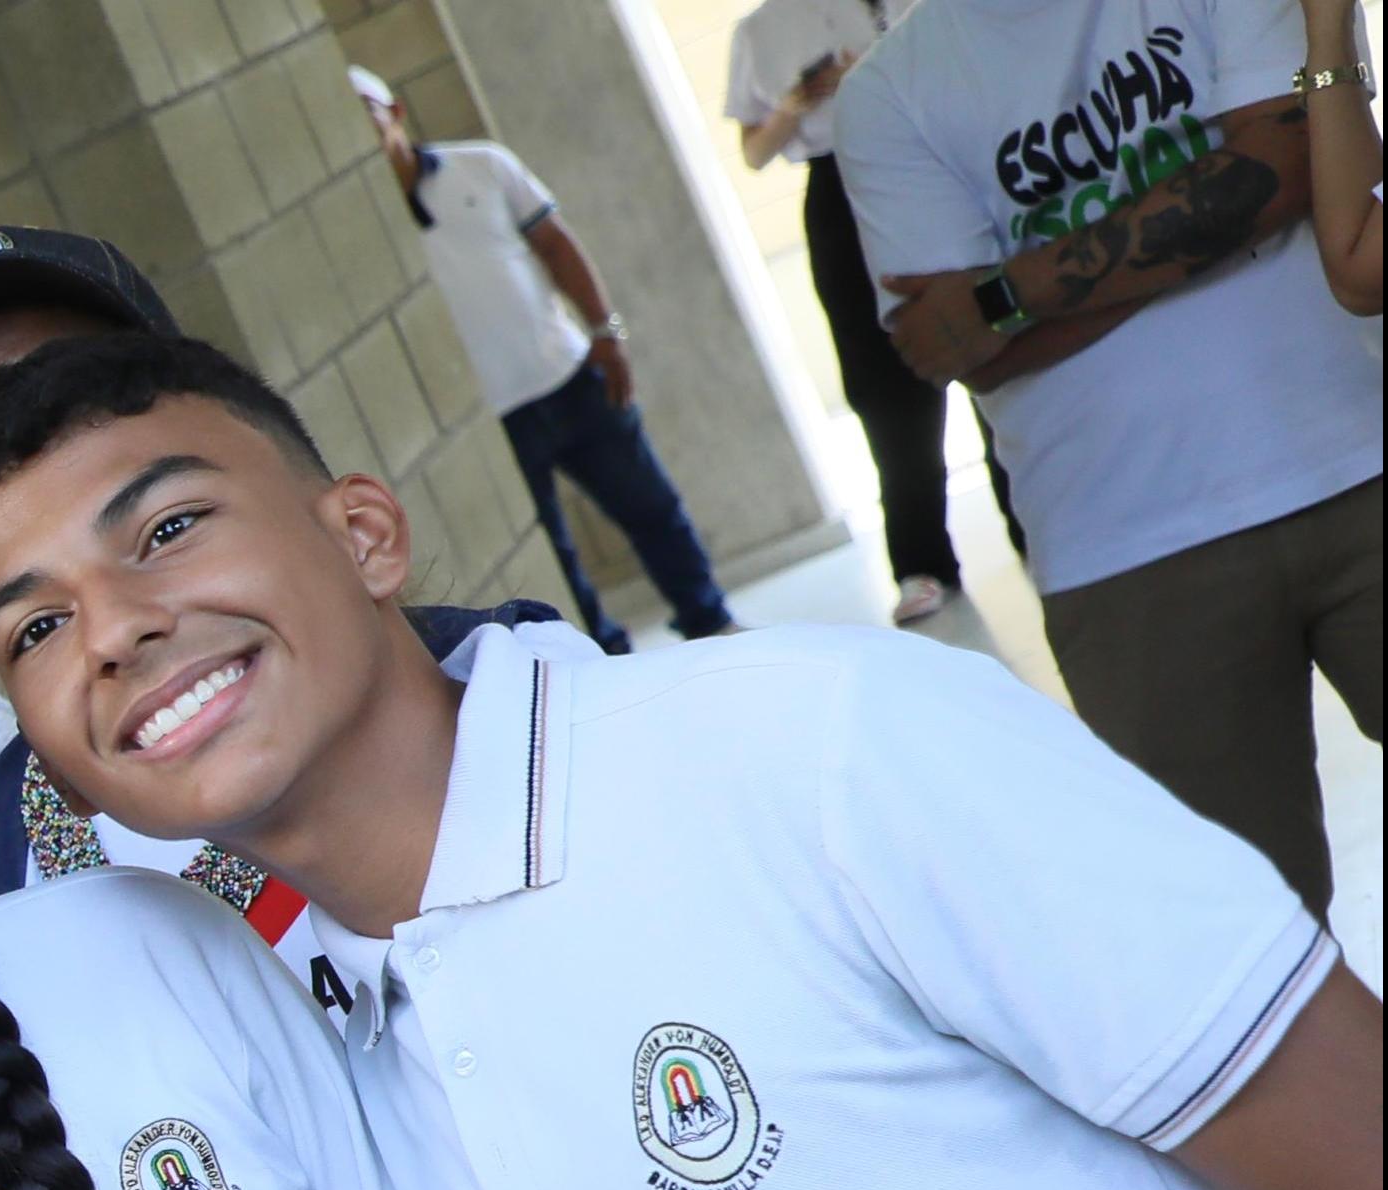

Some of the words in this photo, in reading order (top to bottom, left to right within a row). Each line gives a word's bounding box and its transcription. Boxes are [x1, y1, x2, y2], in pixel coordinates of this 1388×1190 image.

[665, 1029, 694, 1044] VON
[699, 1035, 746, 1095] HUMBOLDT
[124, 1123, 175, 1175] ALEXANDER
[178, 1124, 199, 1146] VON
